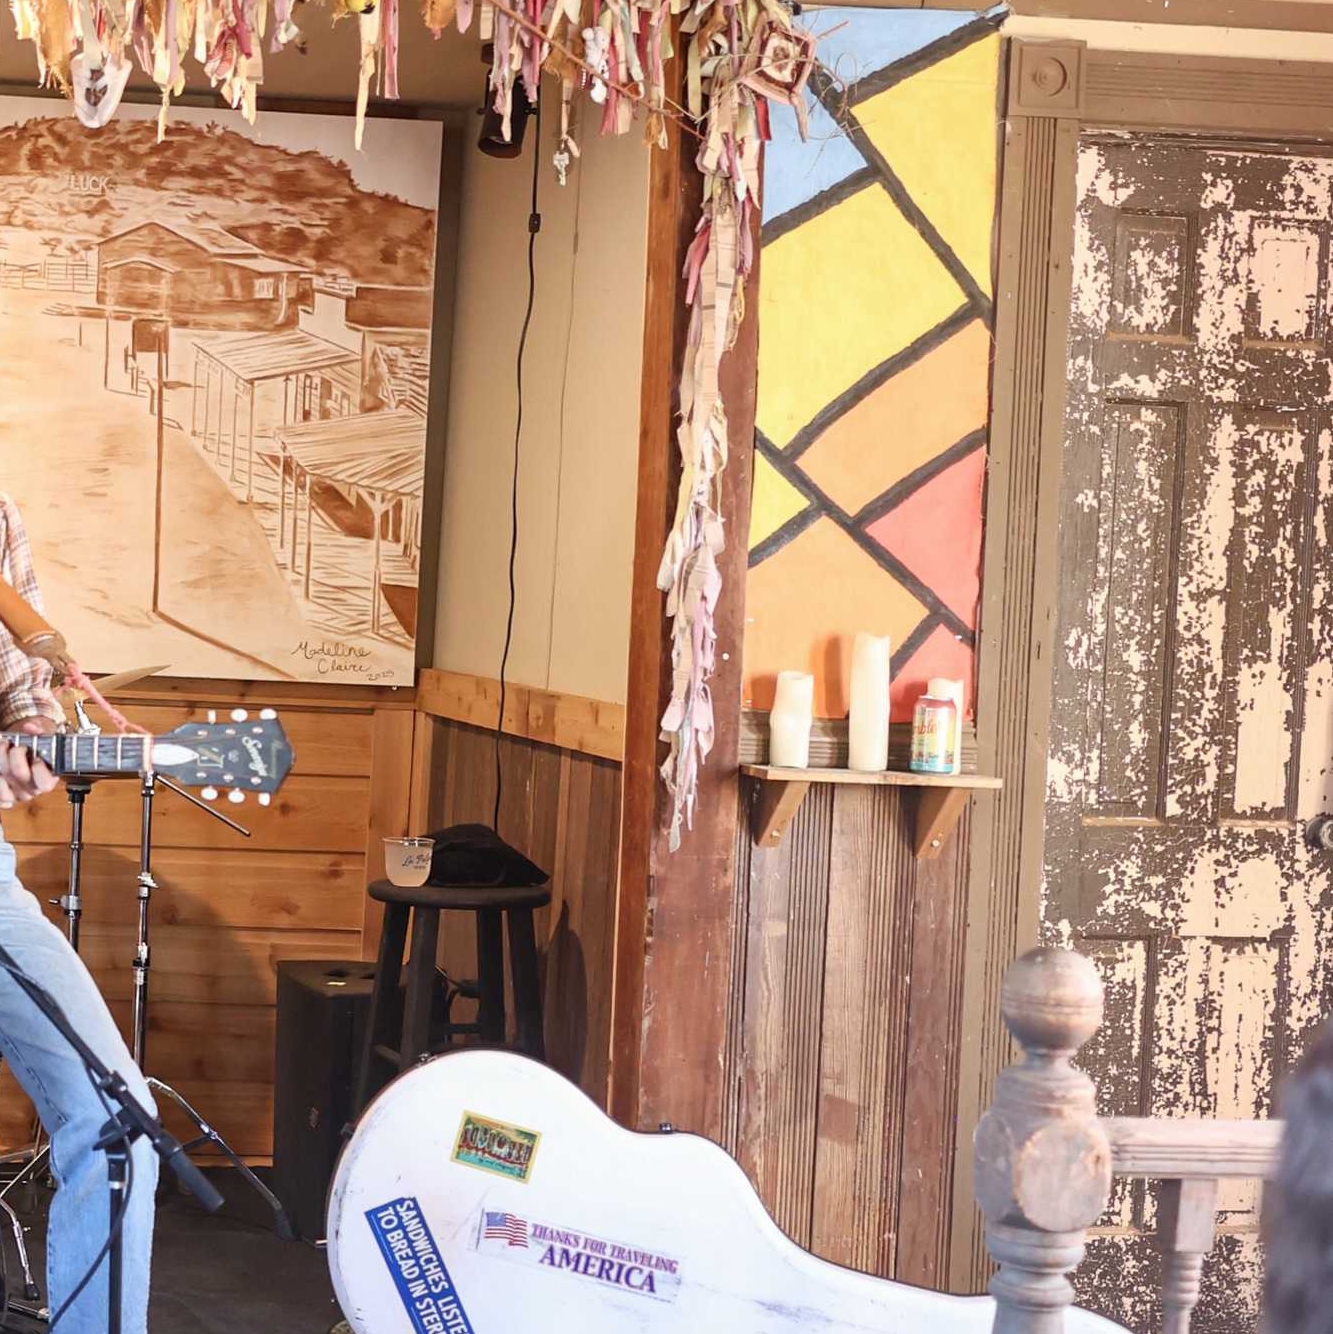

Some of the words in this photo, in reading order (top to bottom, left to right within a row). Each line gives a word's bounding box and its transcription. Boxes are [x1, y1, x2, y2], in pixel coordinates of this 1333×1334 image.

[69, 174, 110, 194] LUCK
[290, 640, 372, 660] Madeline
[317, 658, 372, 675] Claire
[377, 1206, 398, 1230] TO
[386, 1228, 420, 1280] BREAD
[396, 1199, 449, 1294] SANDWICHES
[531, 1223, 581, 1248] THANKS
[583, 1237, 607, 1255] FOR
[609, 1244, 679, 1274] TRAVELING
[538, 1243, 657, 1294] AMERICA
[407, 1279, 429, 1298] IN
